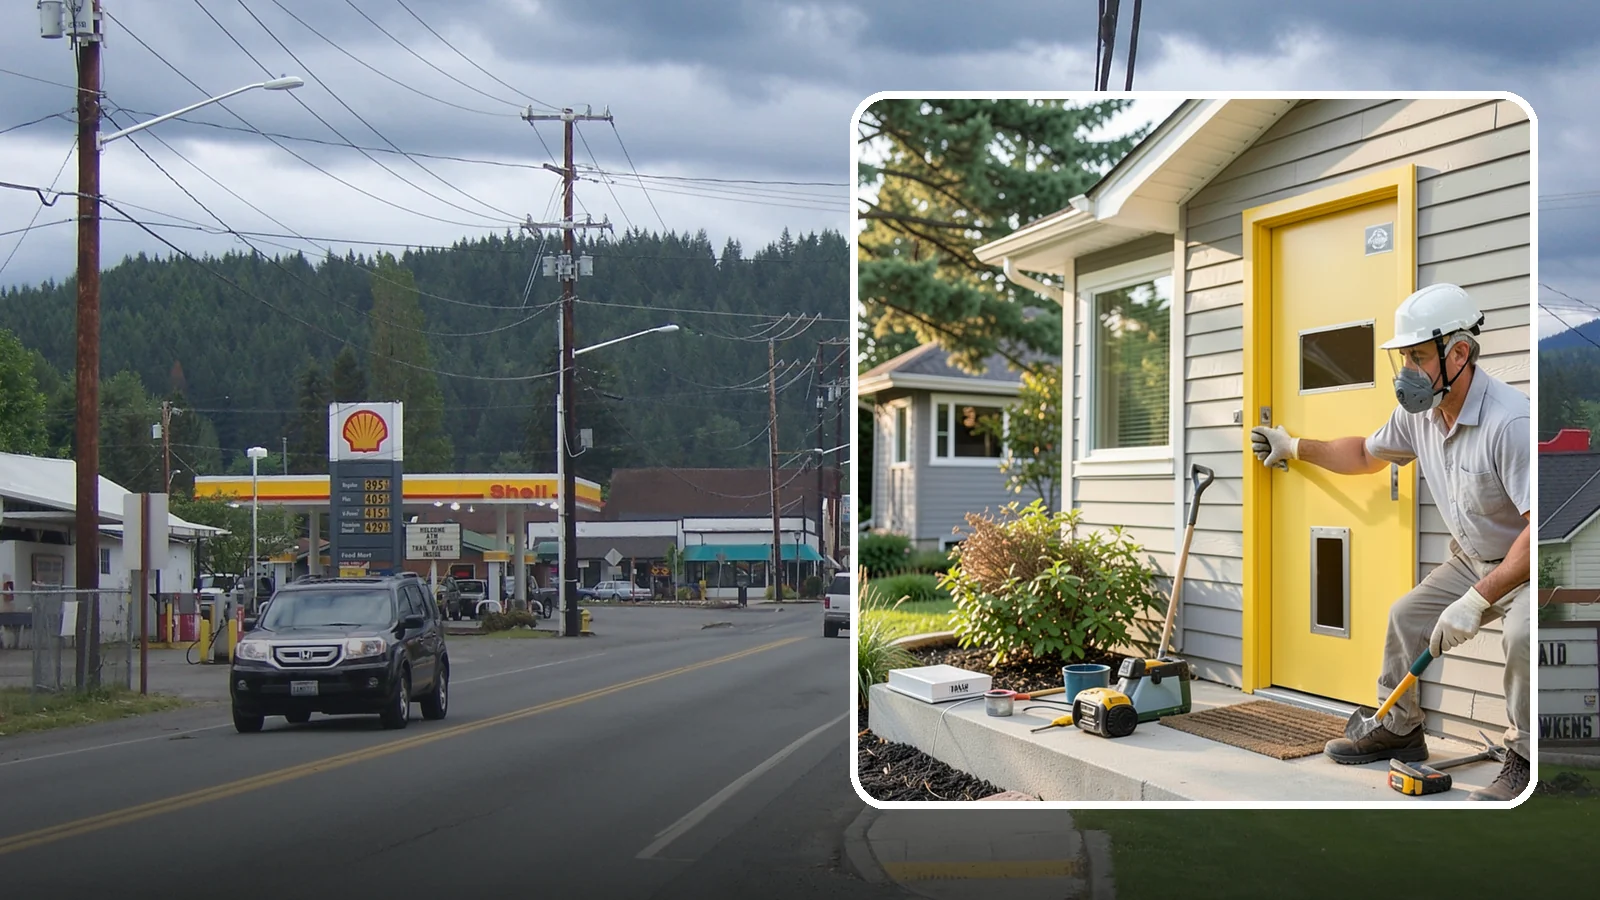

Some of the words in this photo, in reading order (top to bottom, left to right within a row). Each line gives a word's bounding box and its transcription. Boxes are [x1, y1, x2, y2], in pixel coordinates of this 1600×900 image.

[365, 479, 383, 490] 395
[489, 484, 548, 499] Shell
[365, 494, 383, 504] 405
[365, 508, 383, 518] 415
[365, 522, 383, 533] 429
